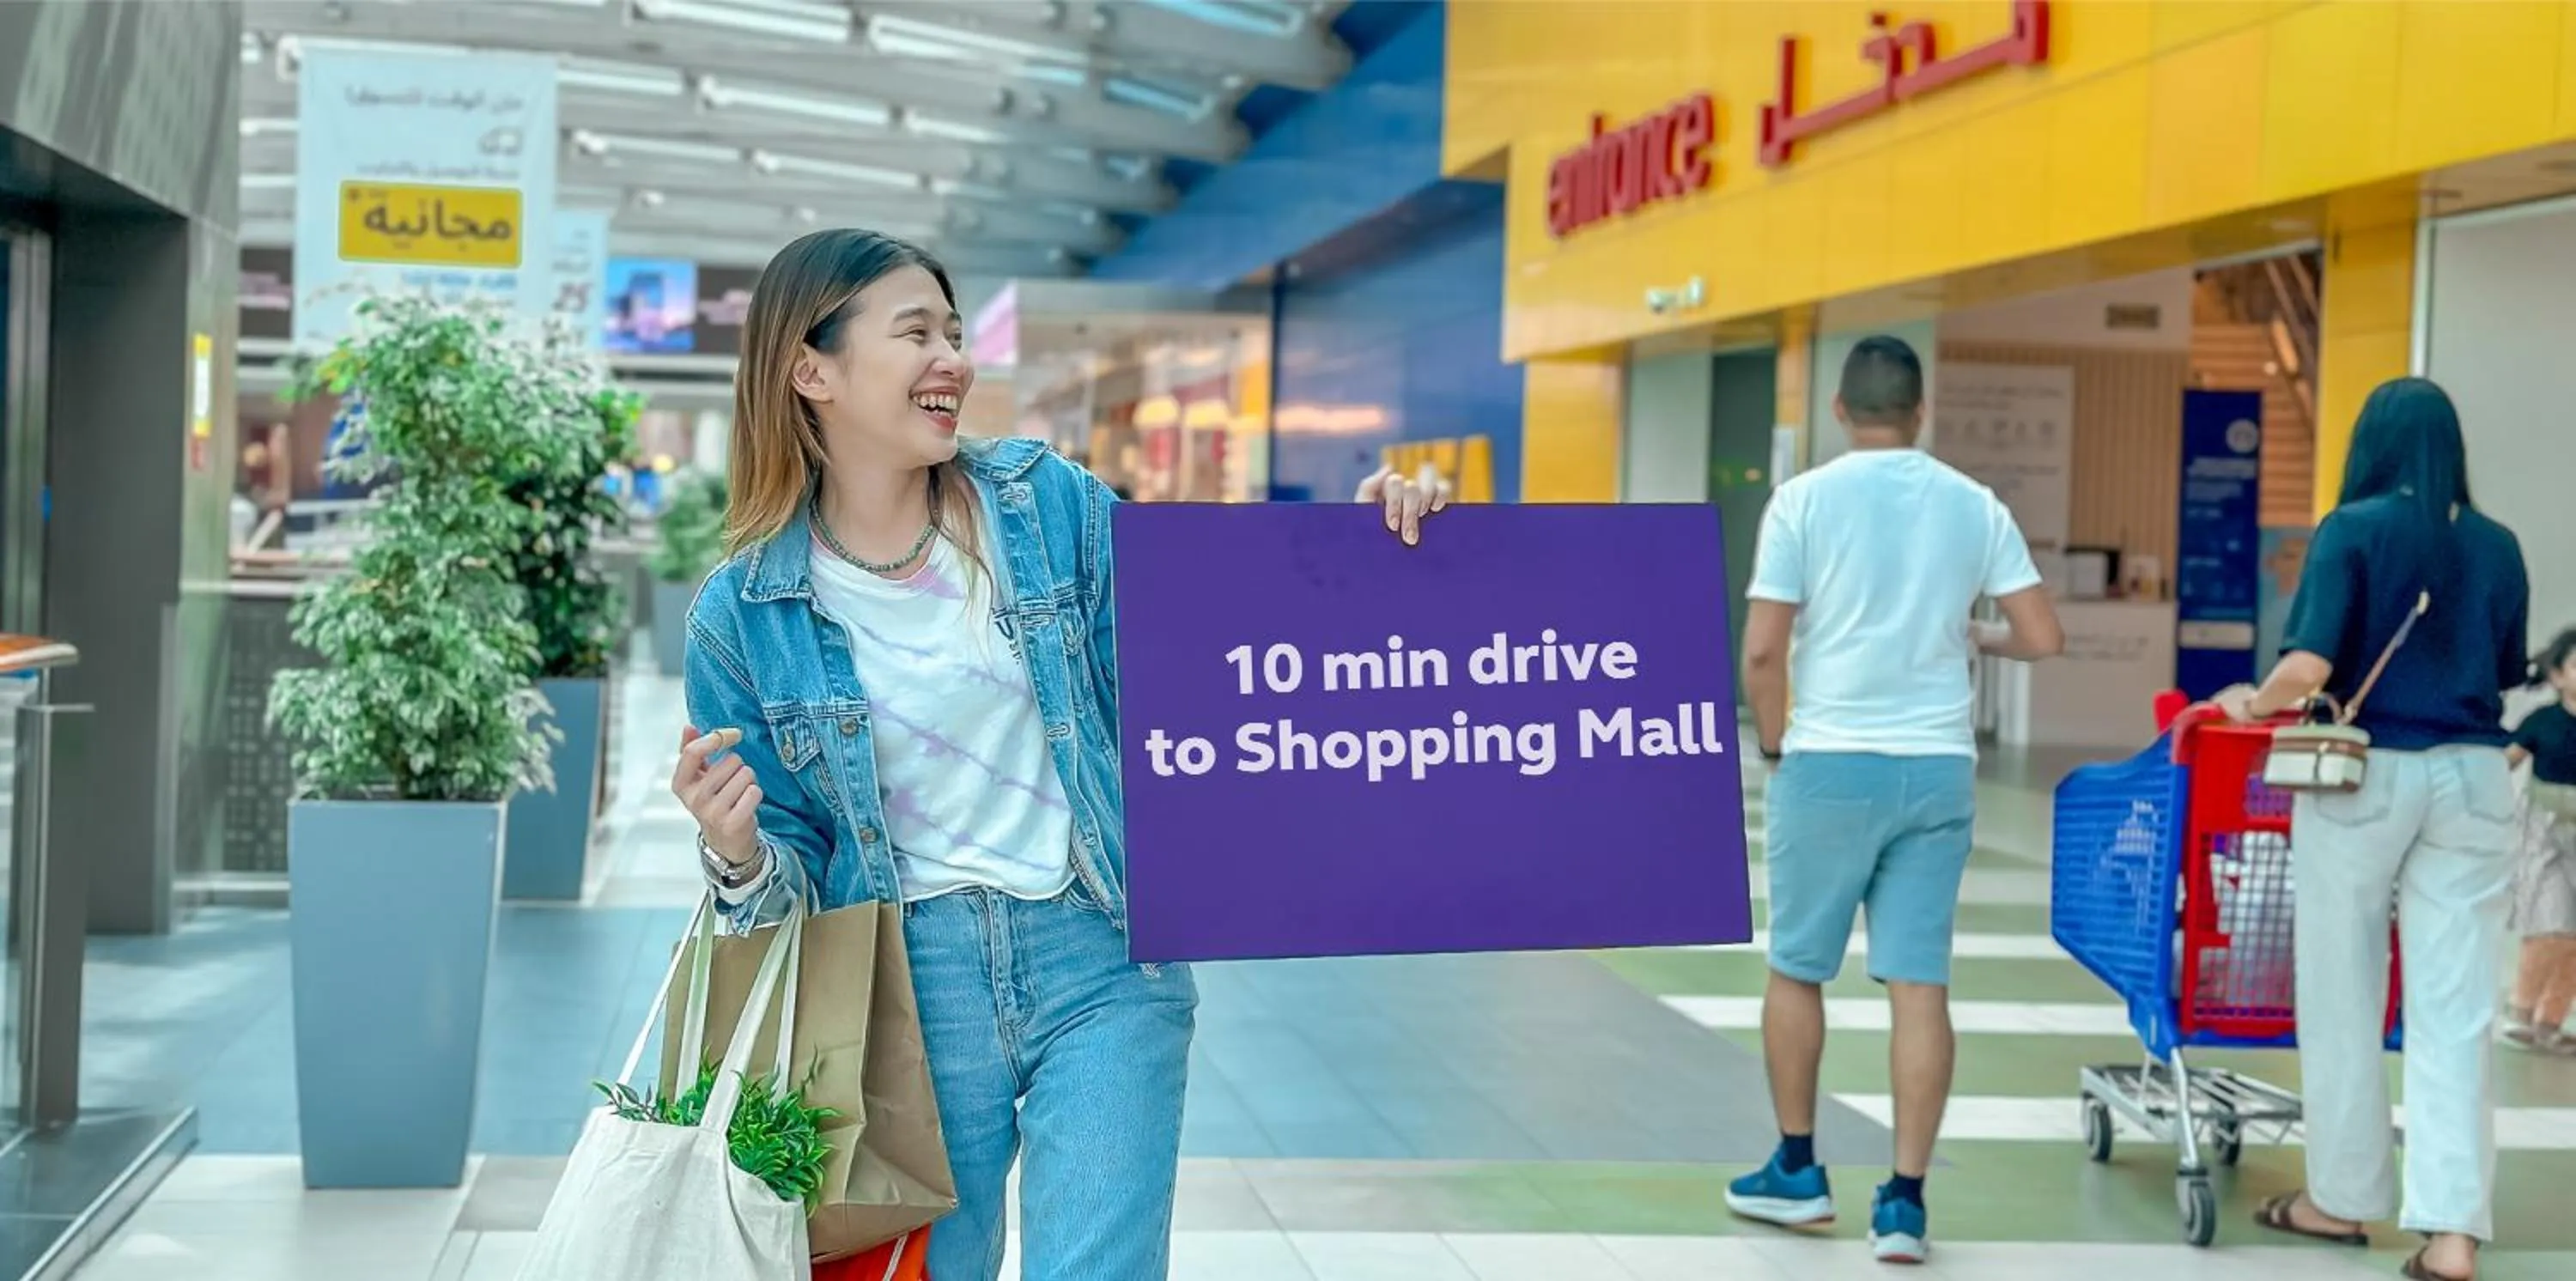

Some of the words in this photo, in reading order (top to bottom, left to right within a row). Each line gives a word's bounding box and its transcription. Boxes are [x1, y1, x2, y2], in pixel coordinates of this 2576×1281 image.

[1548, 93, 1715, 237] entrance
[363, 189, 513, 251] مجانية
[1225, 643, 1303, 695] 10
[1323, 634, 1449, 691] min
[1468, 628, 1637, 684] drive
[1145, 729, 1217, 777] to
[1236, 710, 1557, 782] Shopping
[1578, 701, 1723, 758] Mall
